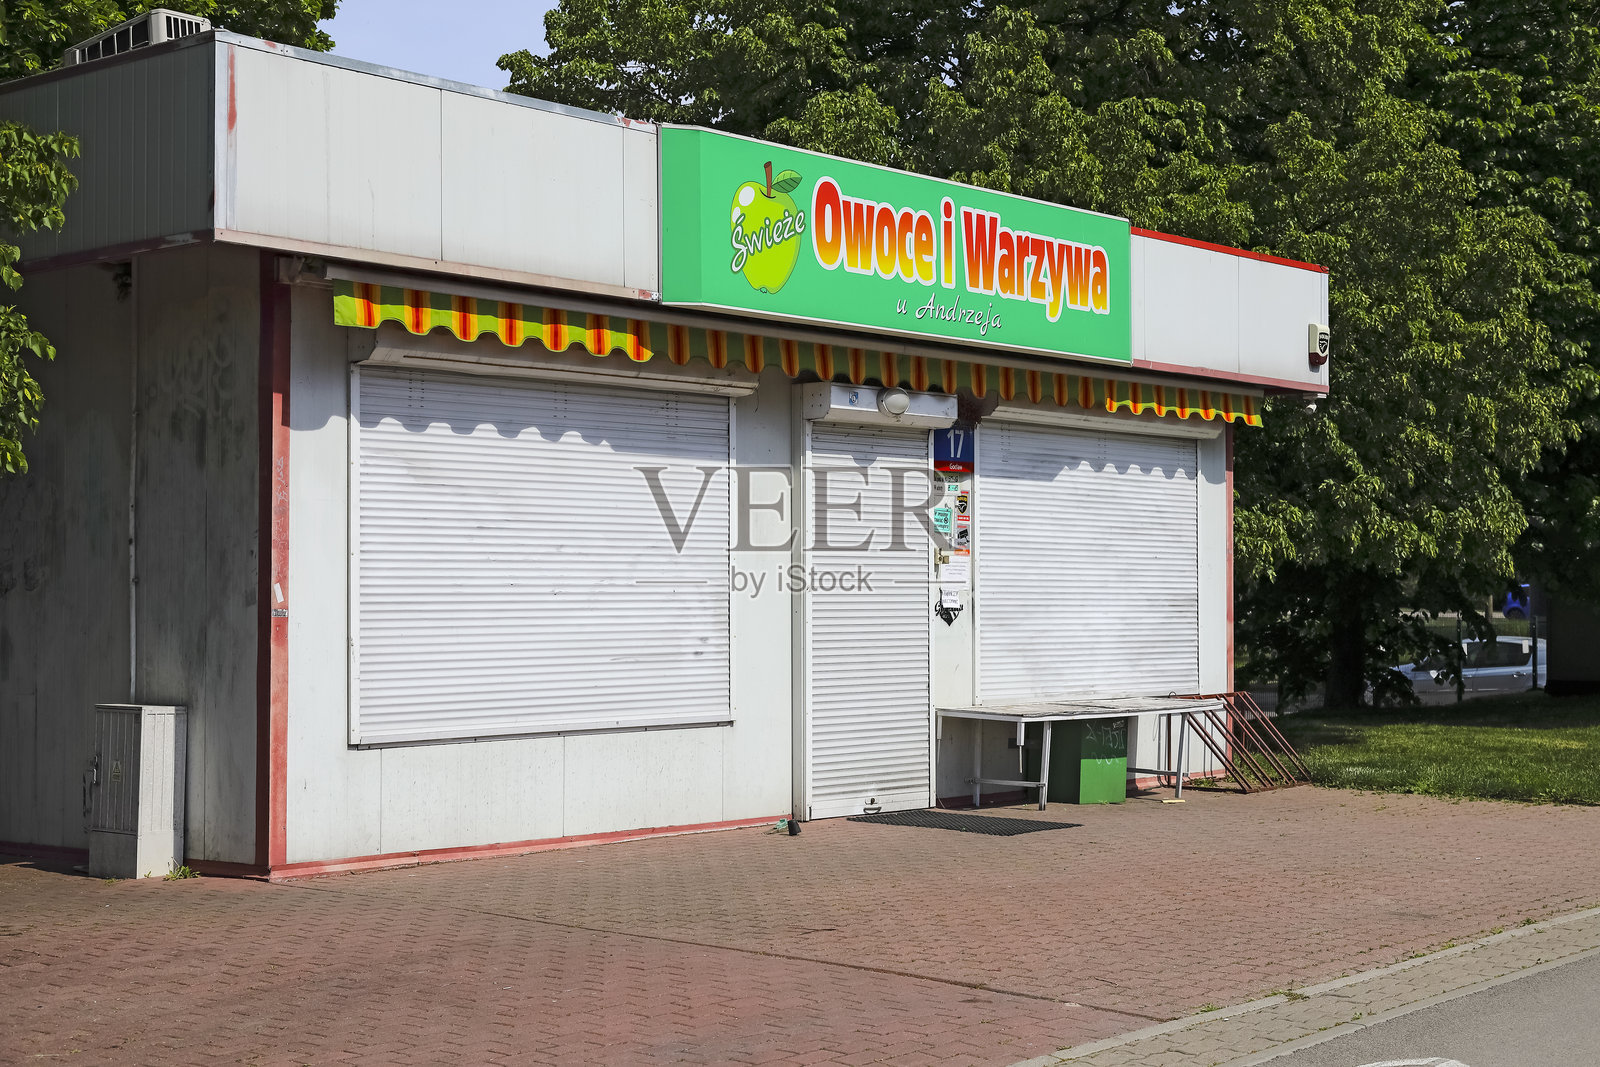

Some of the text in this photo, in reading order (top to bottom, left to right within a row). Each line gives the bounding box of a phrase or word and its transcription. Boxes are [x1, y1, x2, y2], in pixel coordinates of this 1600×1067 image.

[730, 209, 806, 273] Świeże
[812, 176, 1109, 321] Owoce i Warzywa
[897, 292, 1003, 336] u Andrzeja
[947, 429, 964, 458] 17
